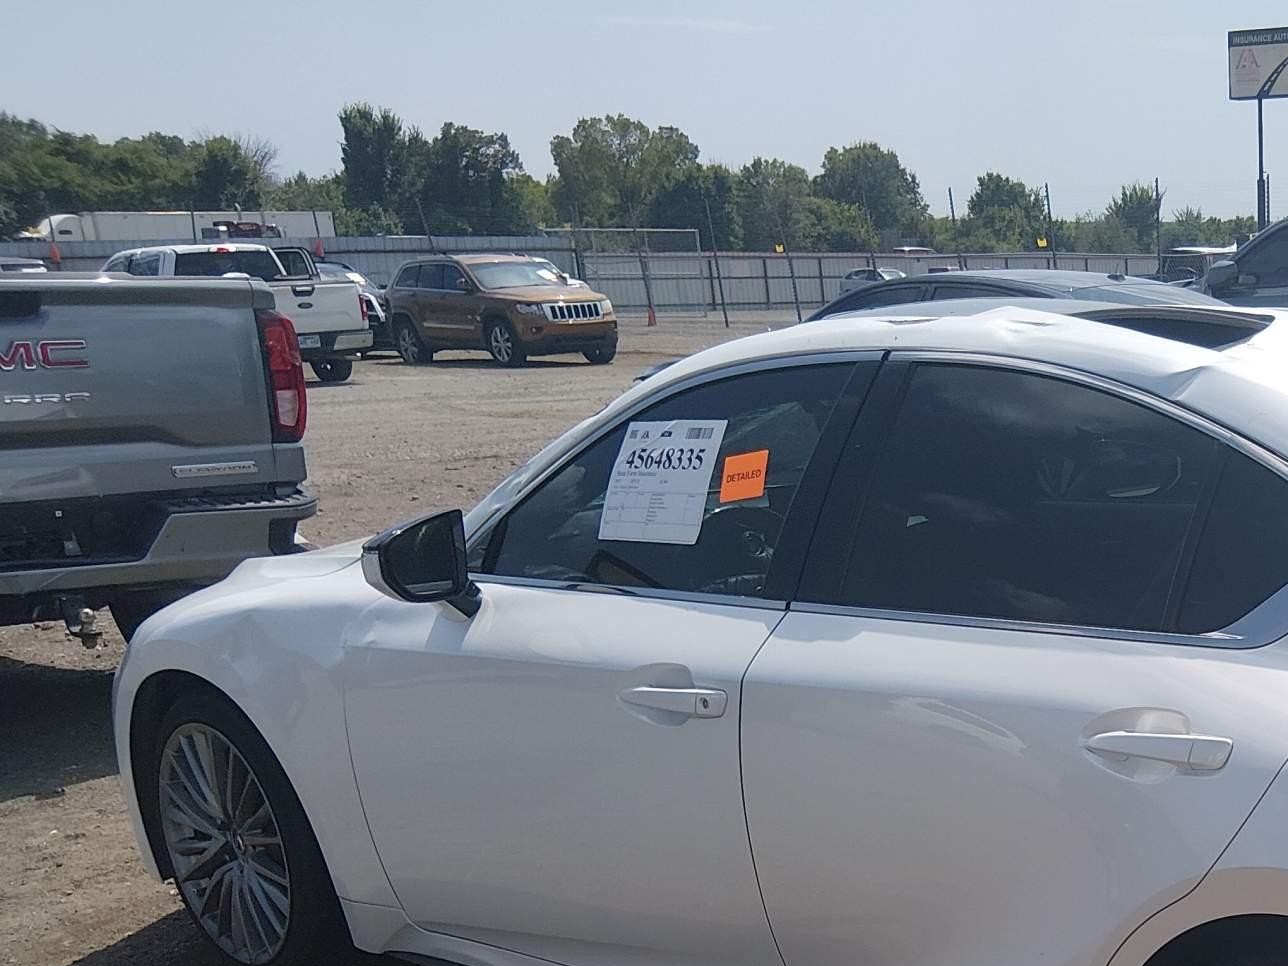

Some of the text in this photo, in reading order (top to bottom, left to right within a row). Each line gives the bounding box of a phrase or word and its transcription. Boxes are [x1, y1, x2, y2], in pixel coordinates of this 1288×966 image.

[1232, 34, 1272, 45] INSURANCE
[626, 447, 707, 470] 45648335
[726, 468, 762, 484] DETAILED
